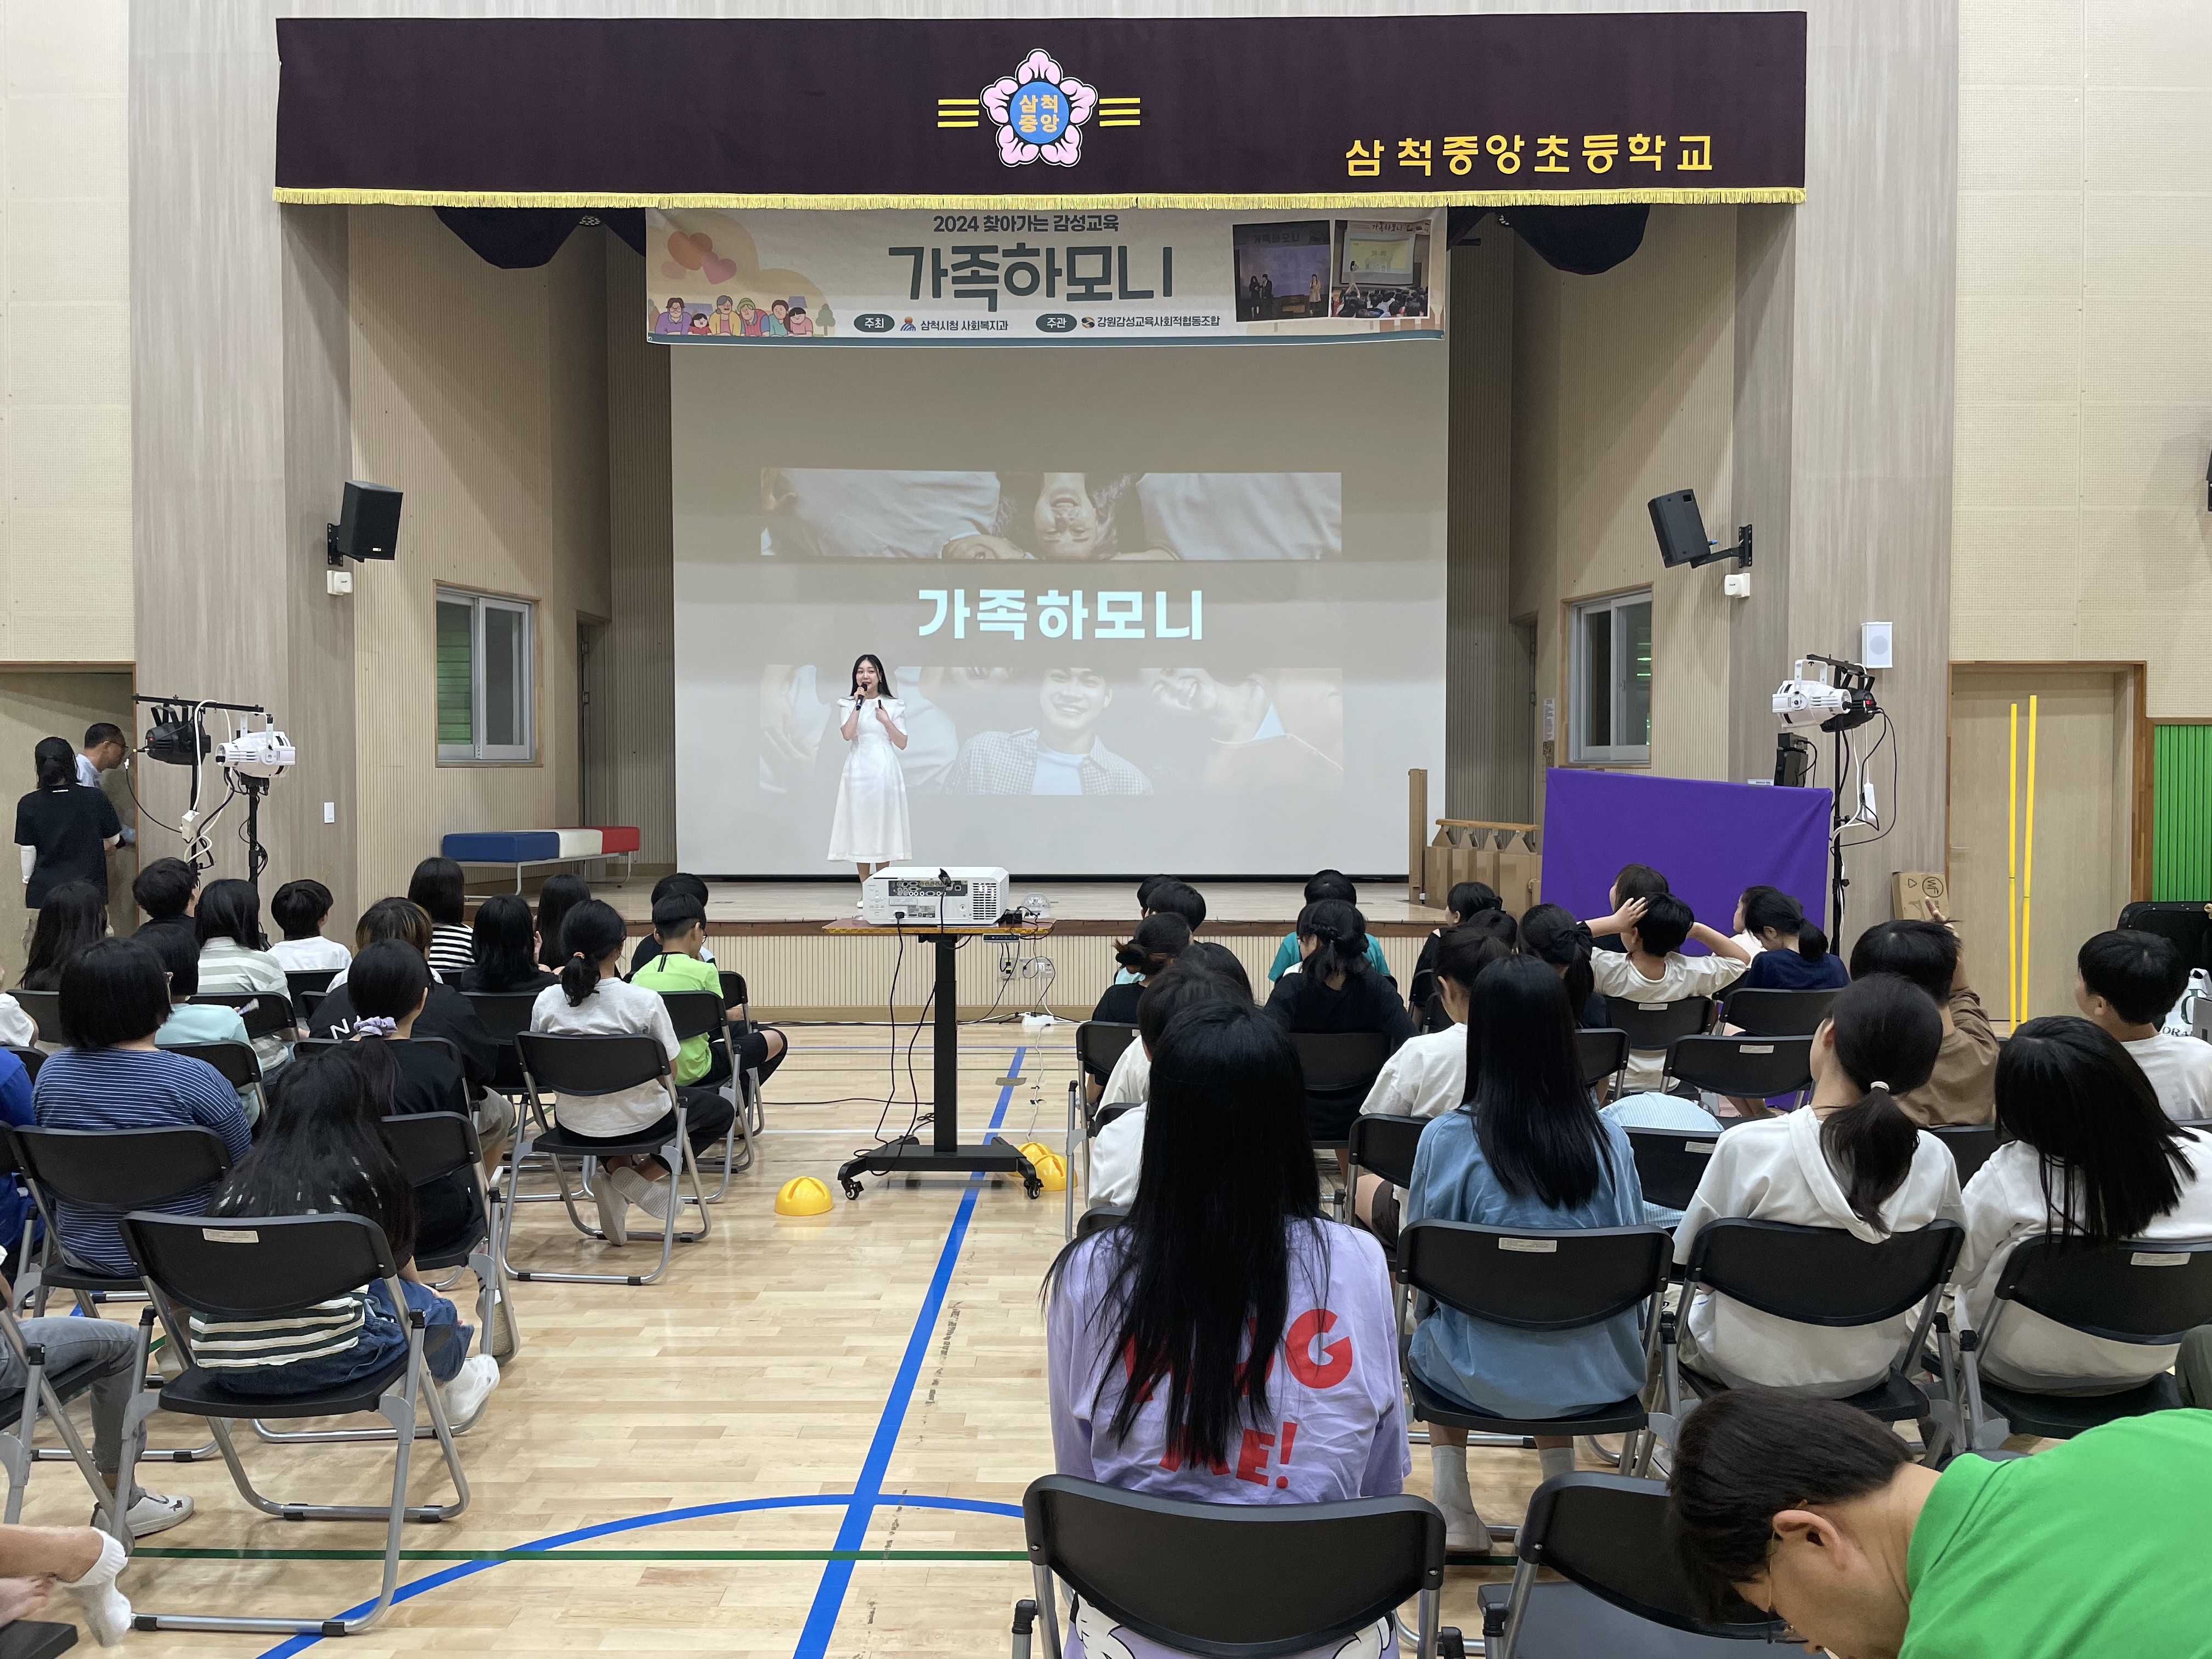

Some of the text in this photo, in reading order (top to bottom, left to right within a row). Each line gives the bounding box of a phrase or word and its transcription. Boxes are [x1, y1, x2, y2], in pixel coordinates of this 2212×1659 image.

[1018, 94, 1059, 114] 삼척
[1018, 114, 1059, 133] 중앙
[1345, 133, 1713, 177] 삼척중앙초등학교
[933, 214, 1119, 233] 2024 찾아가는 감성교육
[888, 242, 1173, 313] 가족하모니
[864, 317, 1009, 331] 주최 삼척시청 사회복지과
[1046, 315, 1221, 329] 주관 강원감성교육사회적협동조합
[918, 588, 1203, 641] 가족하모니
